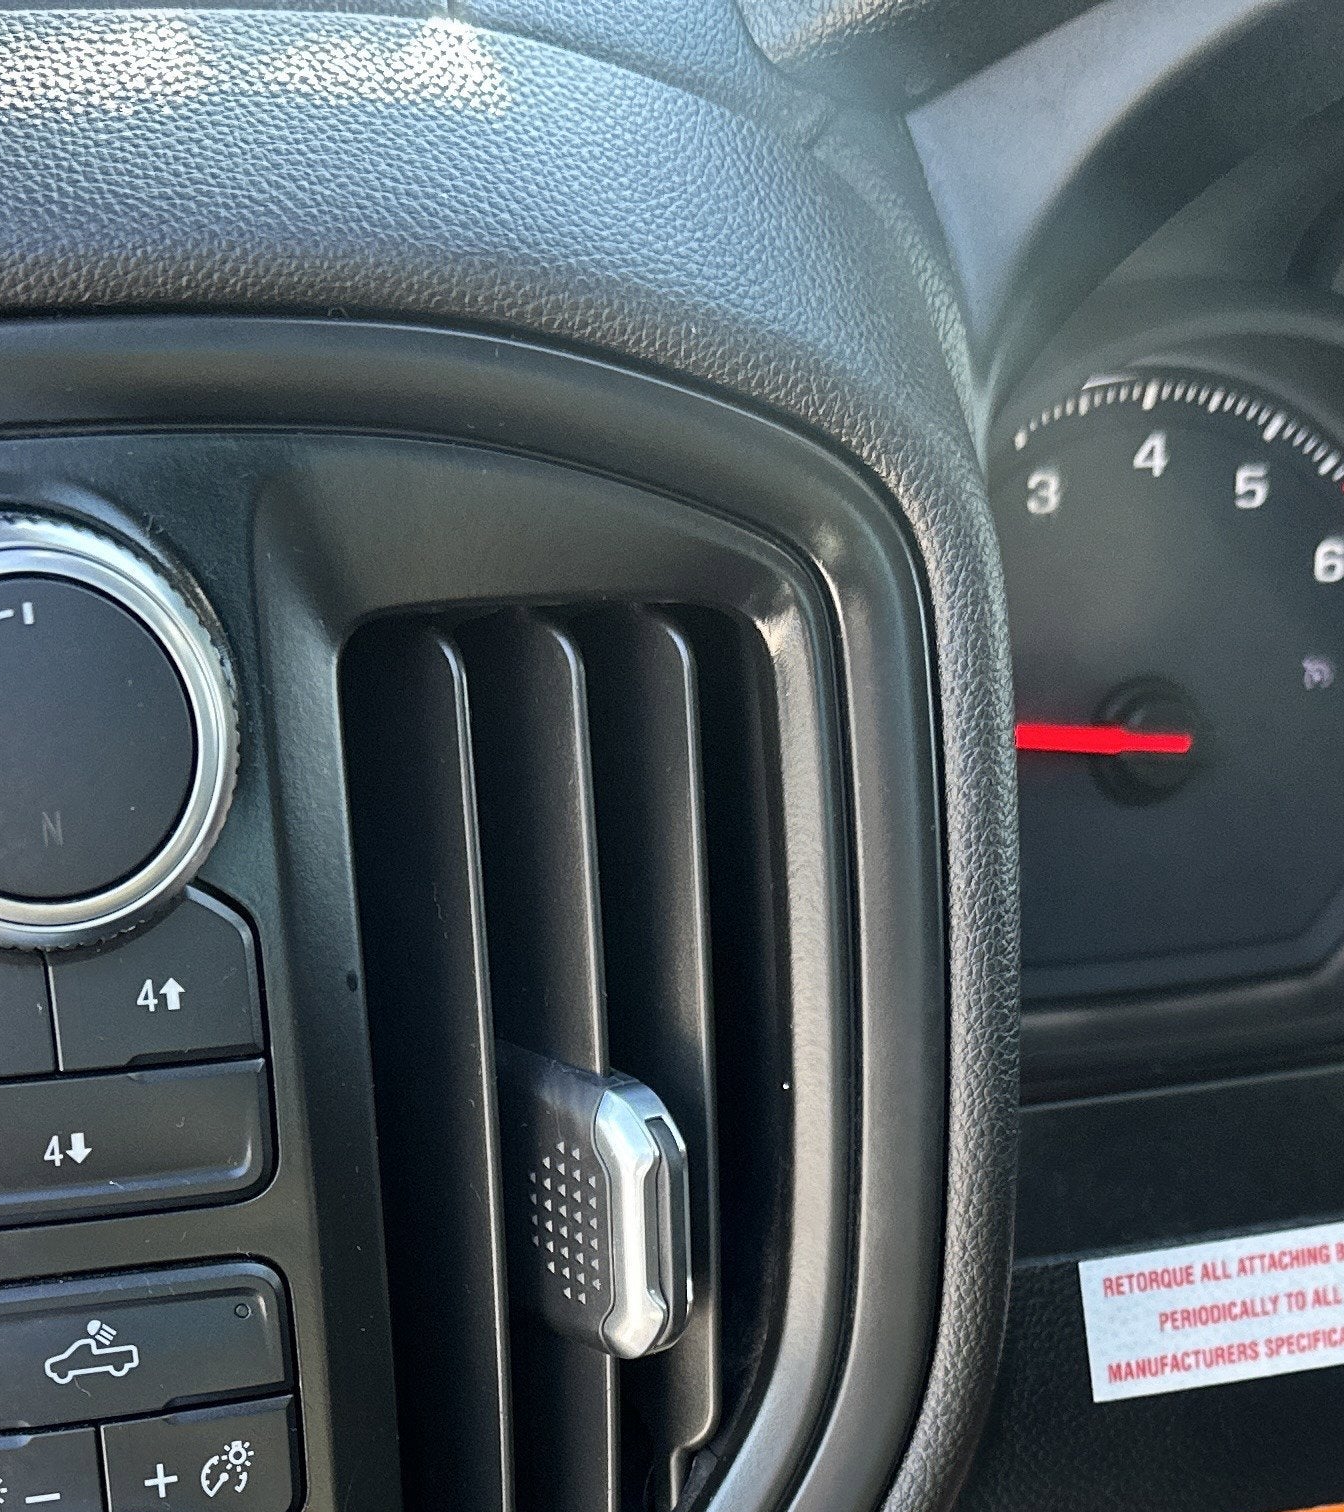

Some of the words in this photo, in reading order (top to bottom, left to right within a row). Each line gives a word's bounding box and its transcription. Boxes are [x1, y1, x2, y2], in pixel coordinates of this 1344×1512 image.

[1133, 430, 1170, 478] 4
[1026, 469, 1061, 515] 3
[1235, 464, 1270, 510] 5
[137, 978, 158, 1012] 4
[43, 1135, 63, 1167] 4
[1102, 1265, 1194, 1297] RETORQUE
[1200, 1259, 1232, 1282] ALL
[1237, 1245, 1331, 1278] ATTACHING
[1158, 1294, 1280, 1332] PERIODICALLY
[1286, 1291, 1307, 1313] TO
[1311, 1284, 1344, 1308] ALL
[1108, 1341, 1260, 1384] MANUFACTURERS
